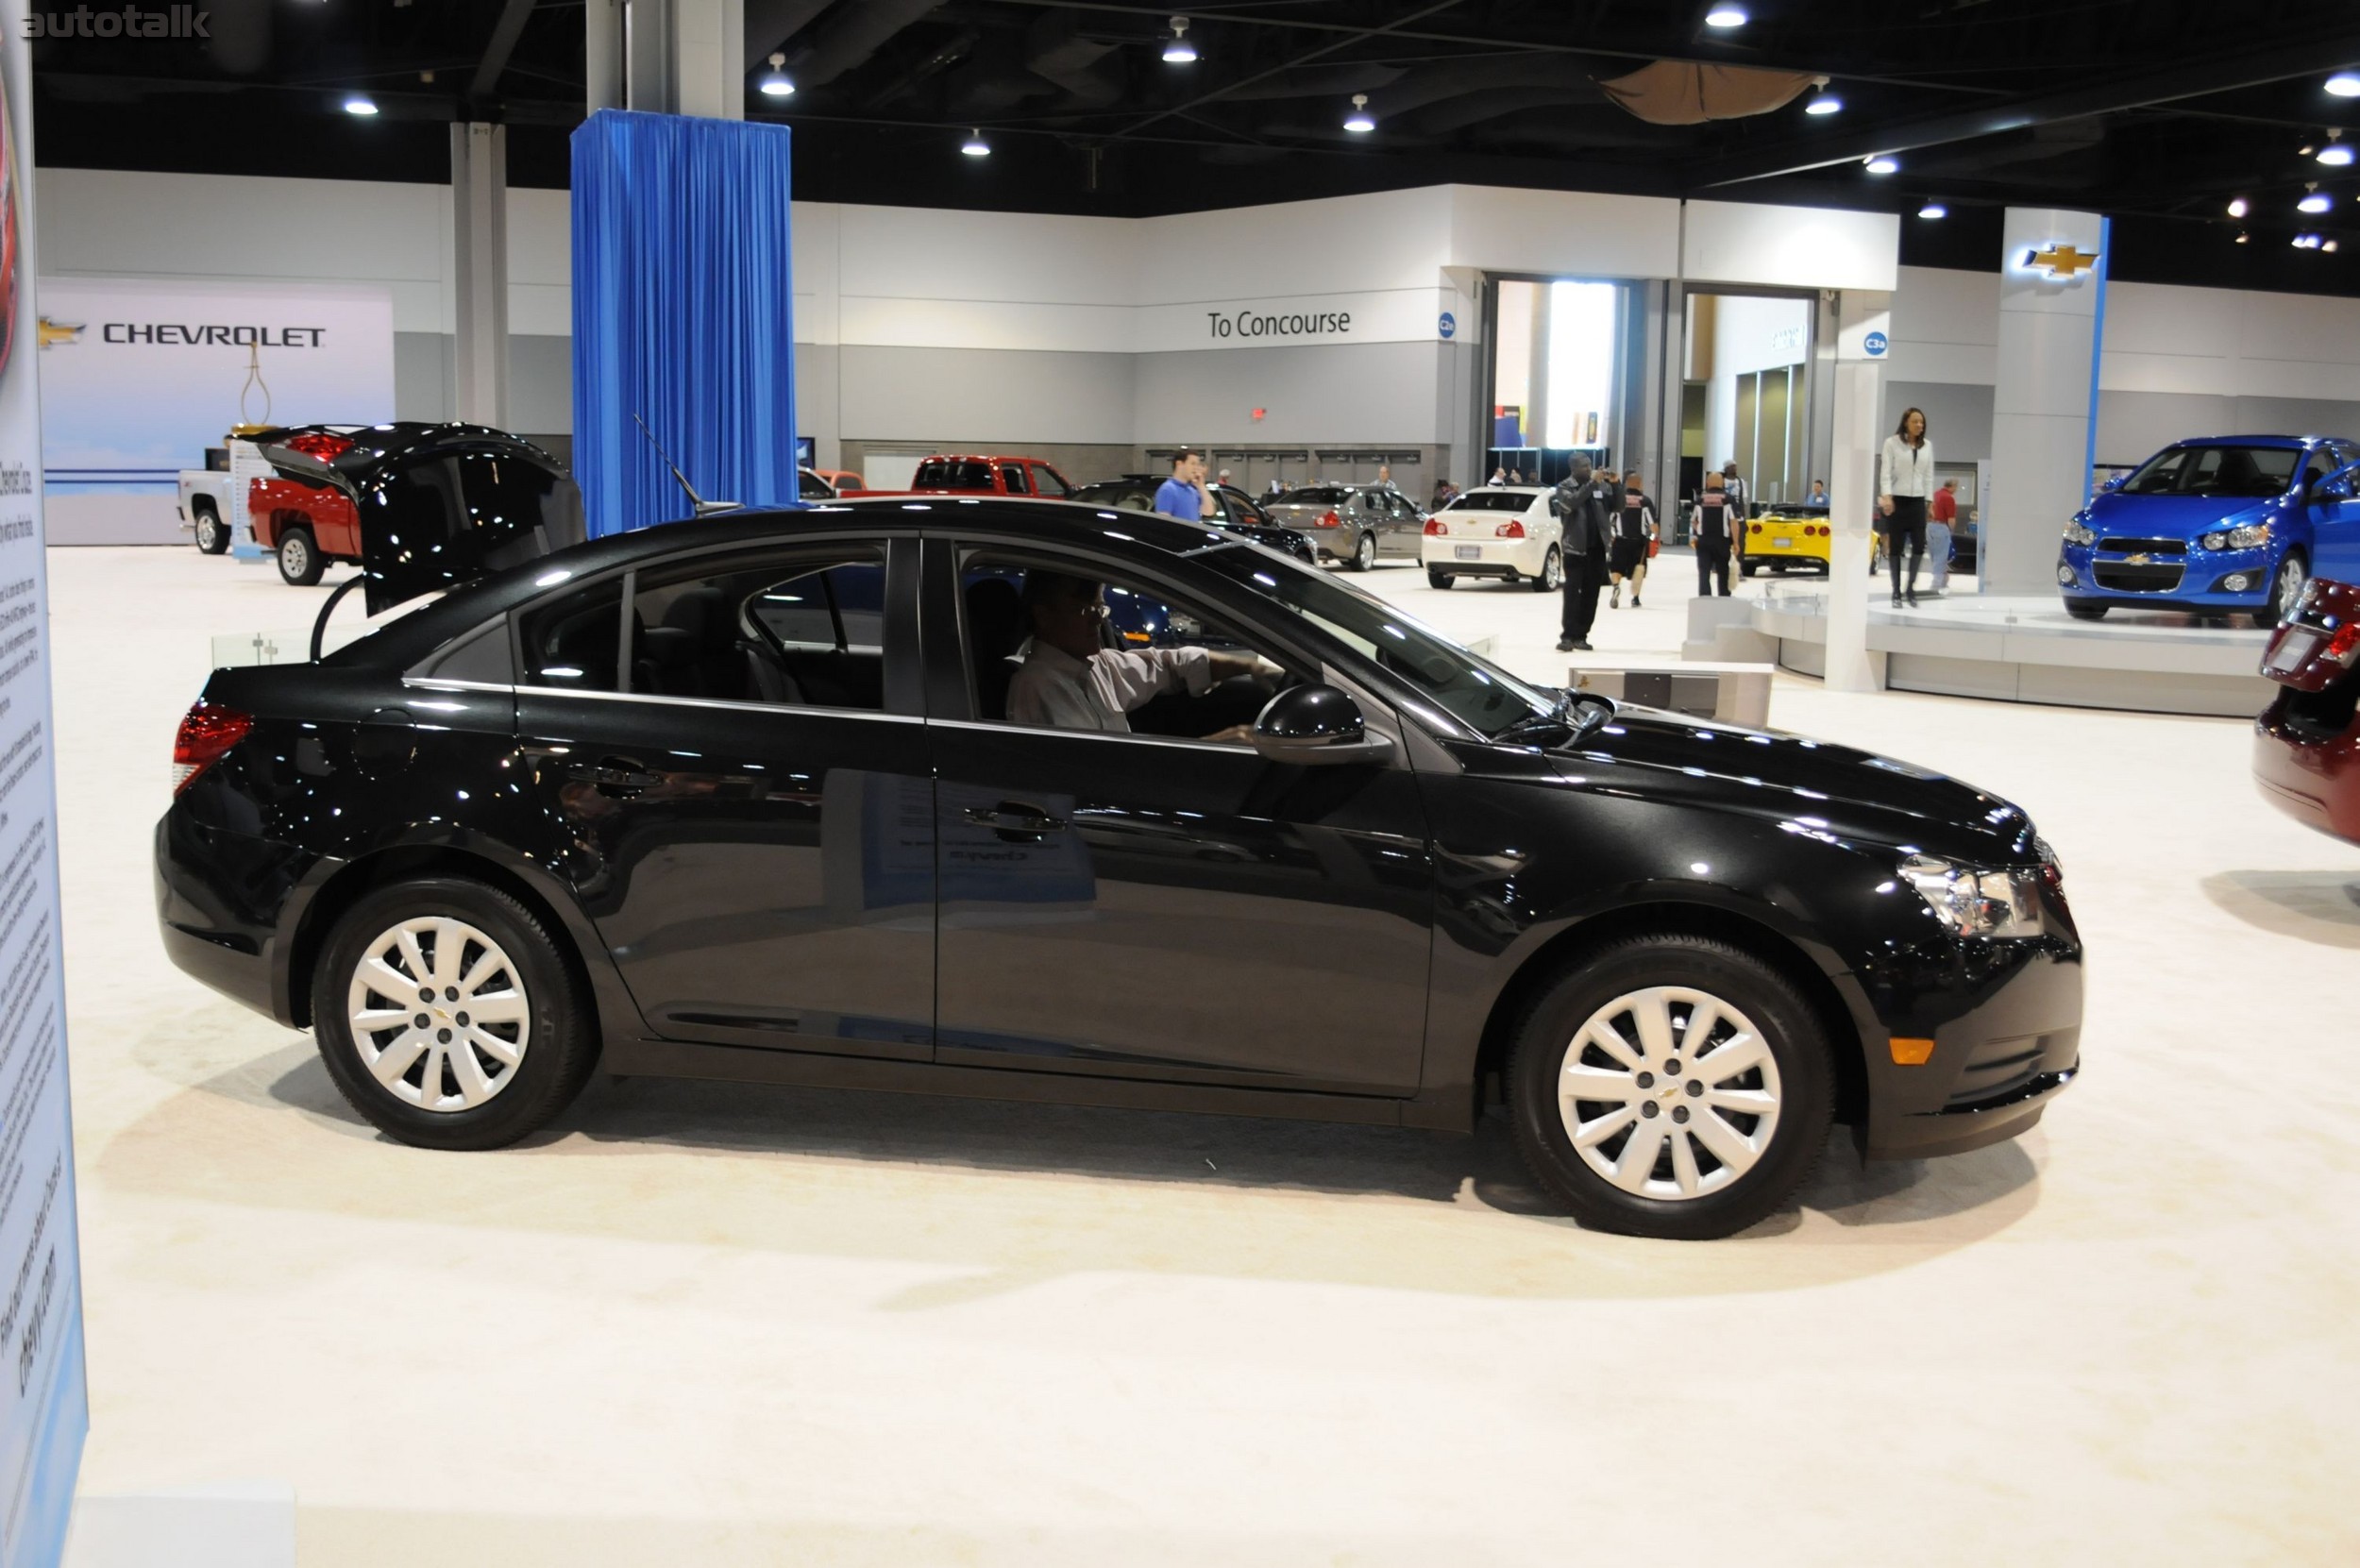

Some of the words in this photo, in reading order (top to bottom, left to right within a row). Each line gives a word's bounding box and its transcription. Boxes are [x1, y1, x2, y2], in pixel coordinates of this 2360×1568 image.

[104, 324, 326, 347] CHEVROLET
[1208, 312, 1231, 337] To
[1238, 311, 1351, 337] Concourse
[19, 1242, 57, 1398] chevy.com
